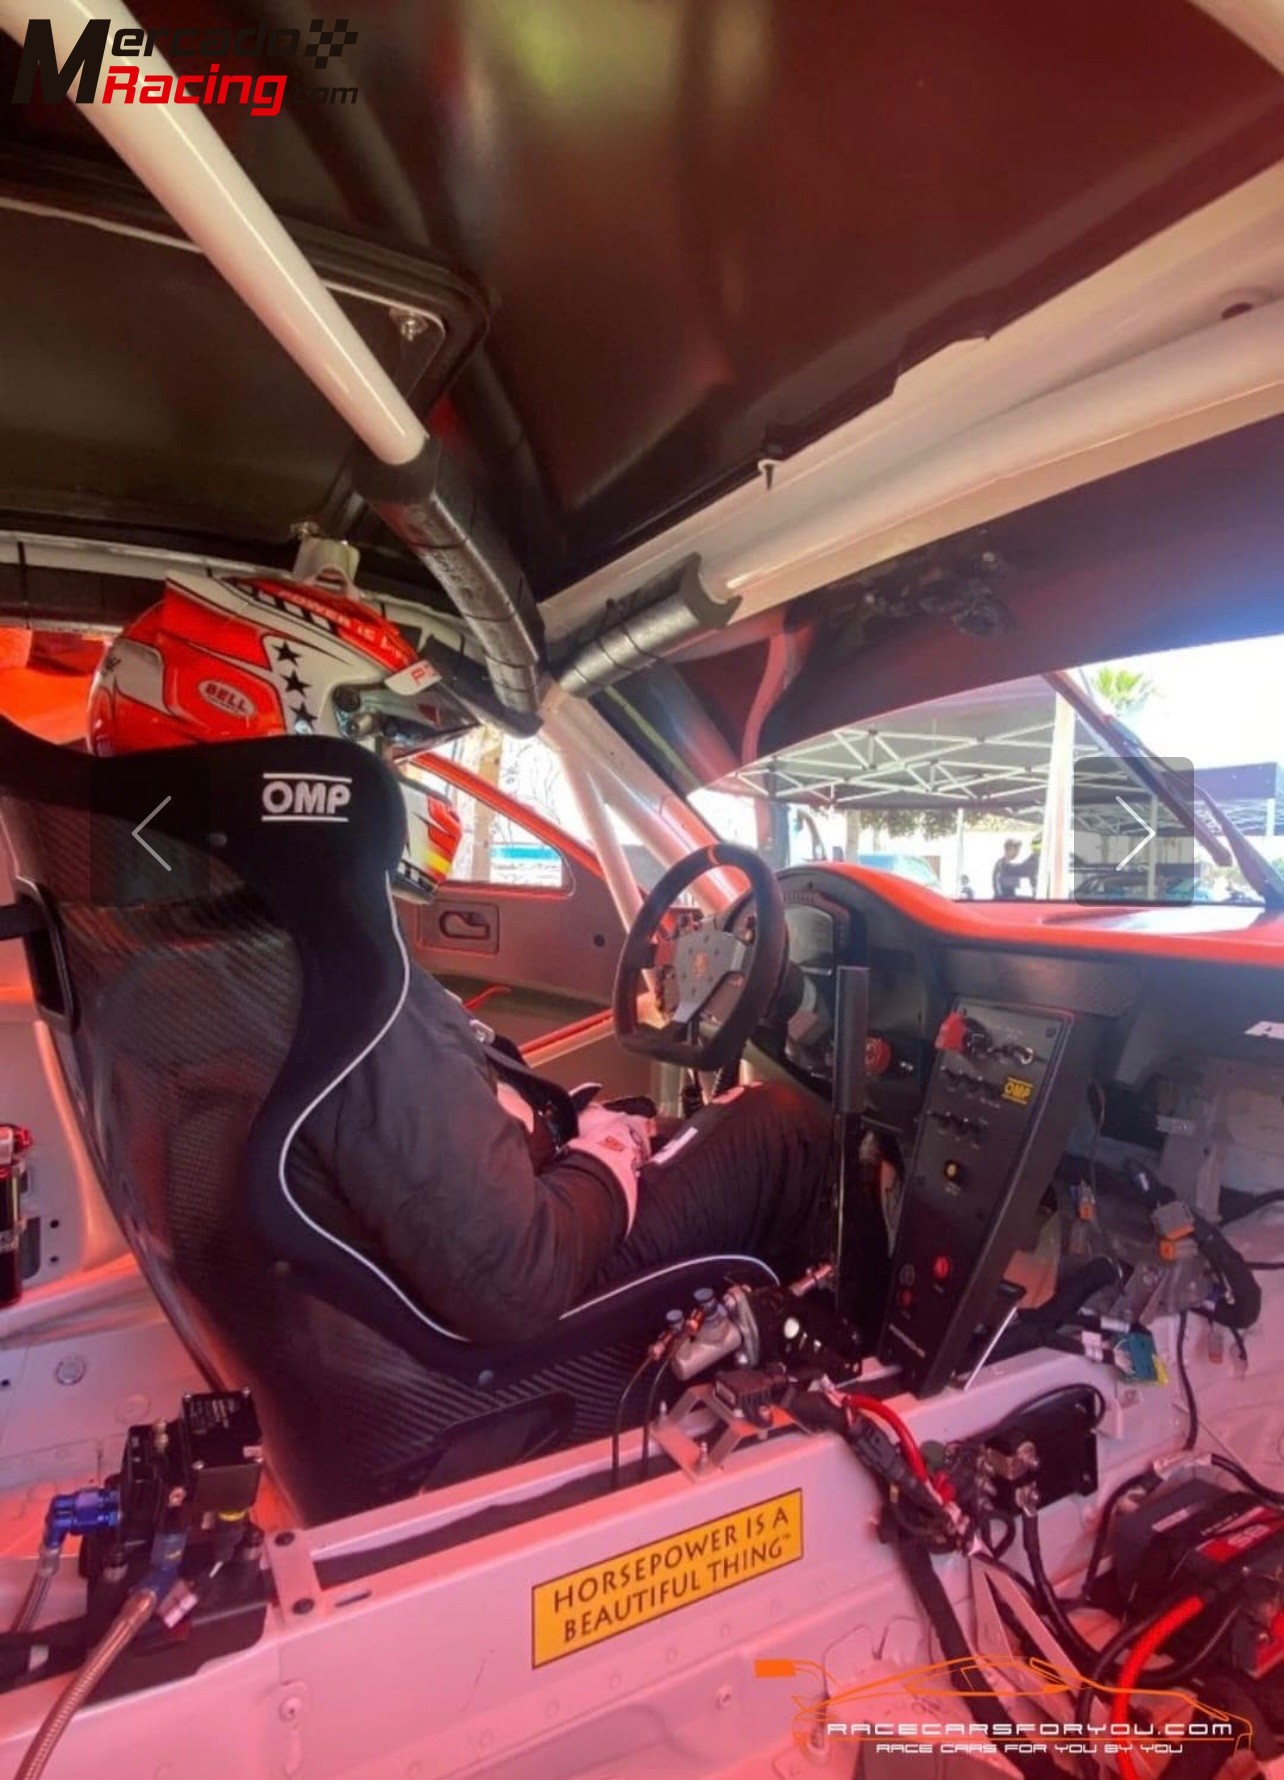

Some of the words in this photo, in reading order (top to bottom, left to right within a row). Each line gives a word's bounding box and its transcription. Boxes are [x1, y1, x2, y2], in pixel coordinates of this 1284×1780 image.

[205, 682, 247, 713] BELL
[262, 780, 352, 815] OMP
[1004, 1081, 1031, 1100] OMP
[553, 1524, 737, 1613] HORSEPOWER
[746, 1513, 766, 1539] IS
[772, 1506, 789, 1530] A
[564, 1569, 701, 1643] BEAUTIFUL
